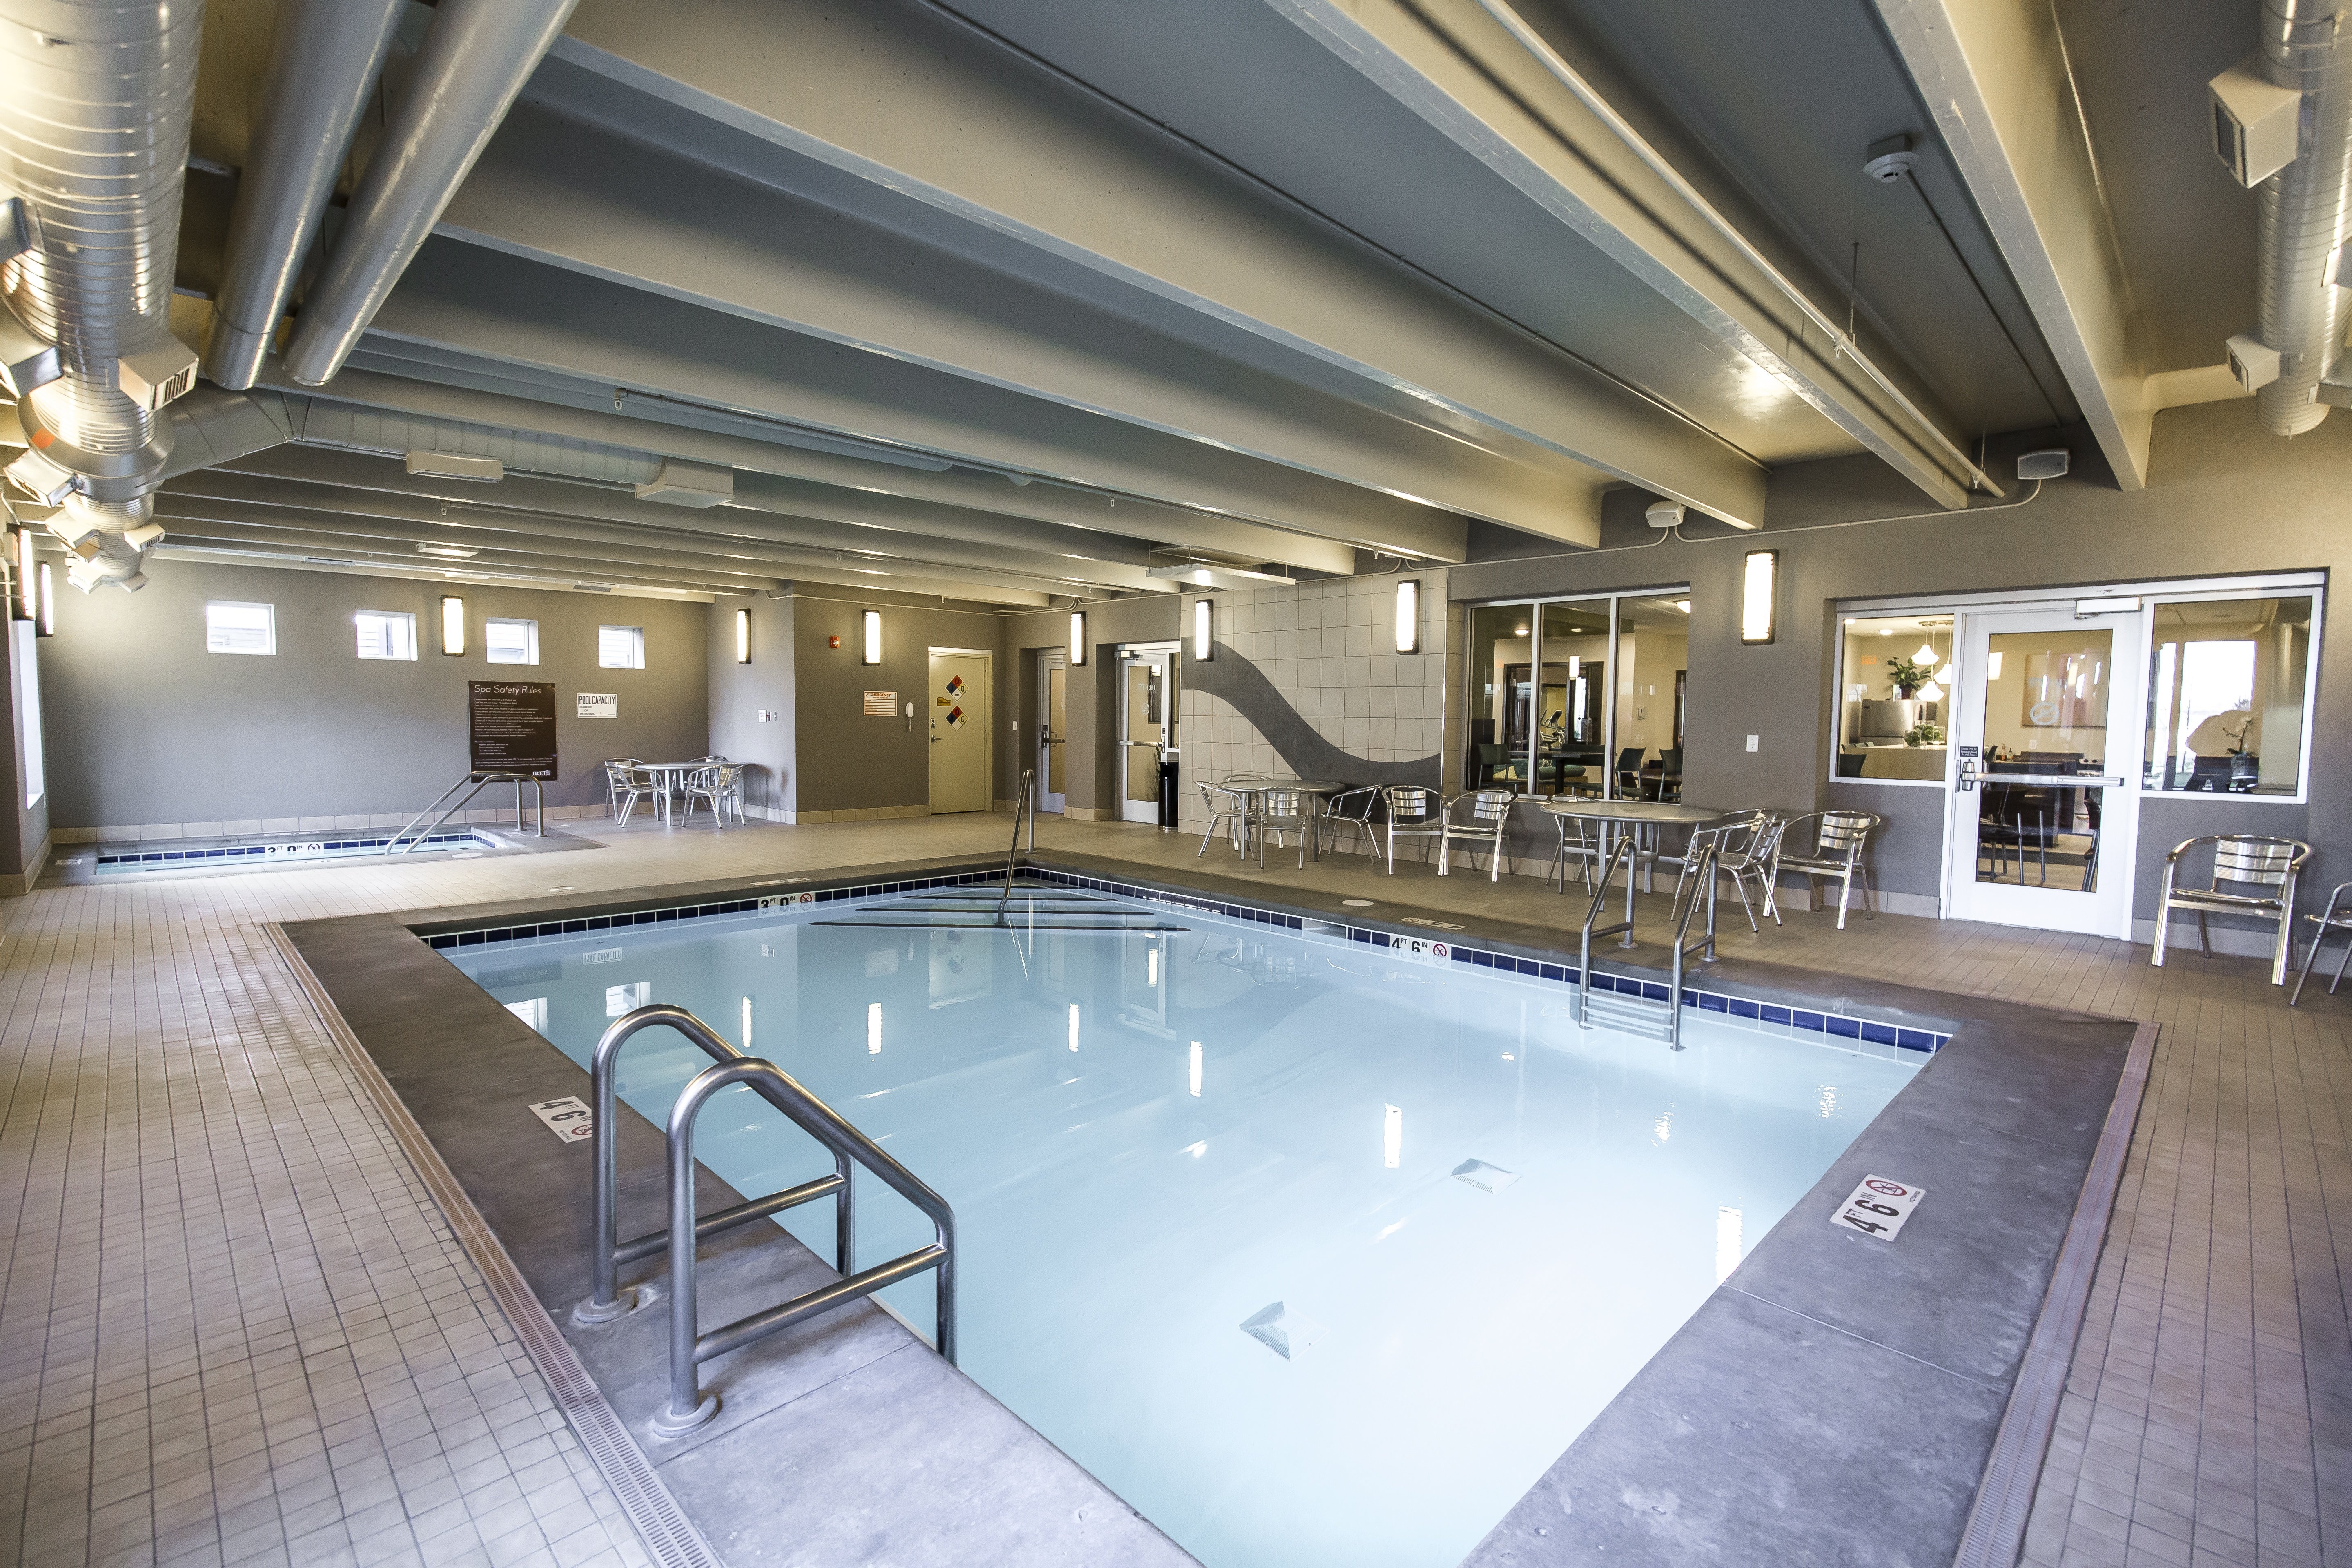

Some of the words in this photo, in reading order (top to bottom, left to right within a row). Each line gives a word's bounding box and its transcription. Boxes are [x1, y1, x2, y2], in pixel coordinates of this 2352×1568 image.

[474, 685, 491, 694] Spa
[494, 685, 520, 695] Safety
[579, 696, 591, 704] POOL
[592, 696, 615, 705] CAPACITY
[761, 899, 769, 909] 3
[1392, 937, 1401, 949] 4
[1412, 940, 1420, 953] 6
[540, 1101, 575, 1110] 4
[550, 1110, 586, 1121] 6
[1860, 1192, 1877, 1201] IN
[1846, 1208, 1864, 1218] FT
[1855, 1200, 1899, 1216] 6
[1843, 1215, 1889, 1233] 4
